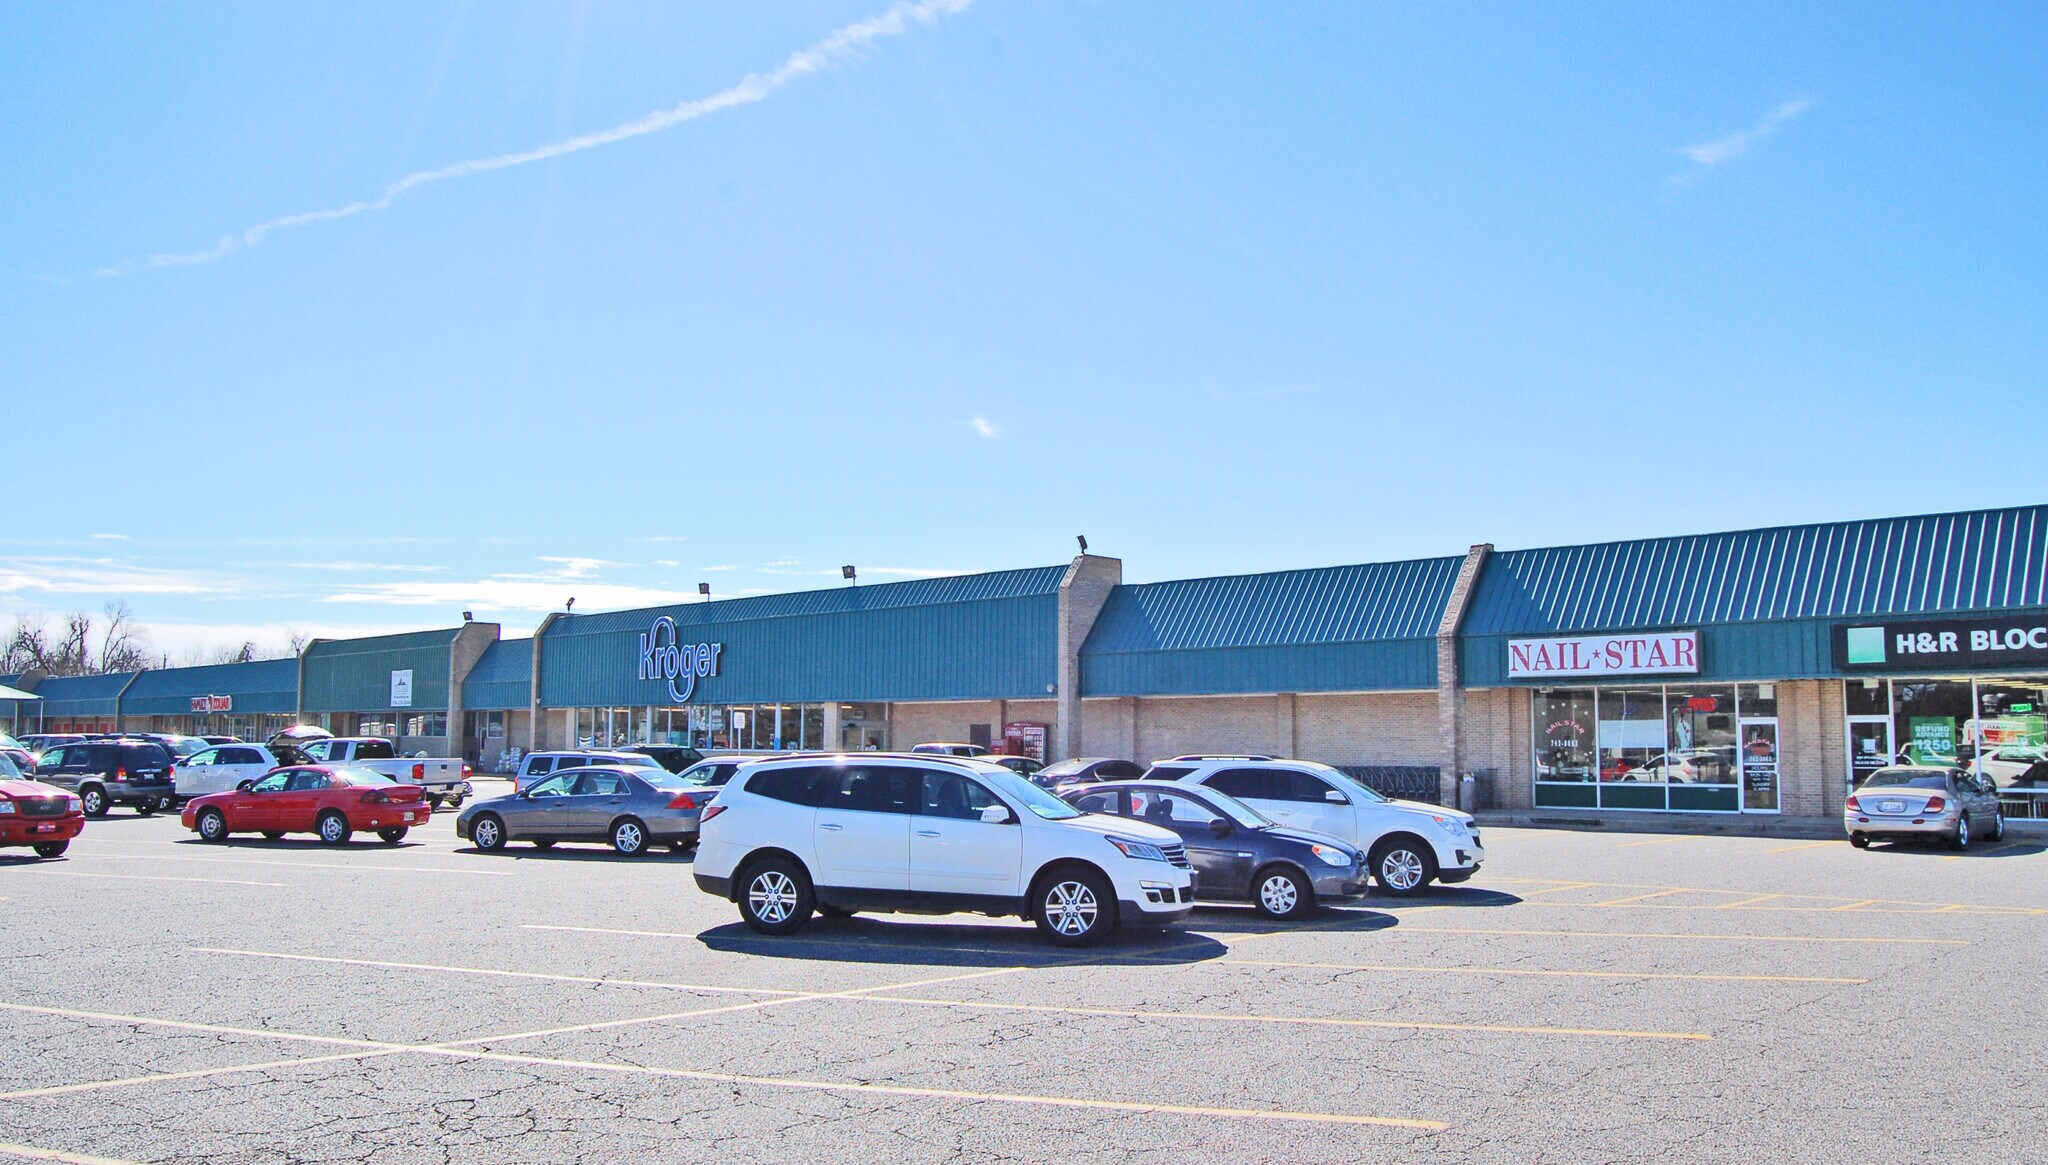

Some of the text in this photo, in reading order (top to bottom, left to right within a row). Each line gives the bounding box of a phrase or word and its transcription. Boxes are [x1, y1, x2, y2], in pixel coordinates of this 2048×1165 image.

[1509, 638, 1695, 672] NAIL STAR
[1896, 627, 2048, 654] H&R BLOC
[639, 615, 721, 702] Kroger
[1546, 720, 1585, 734] NAIL STAR
